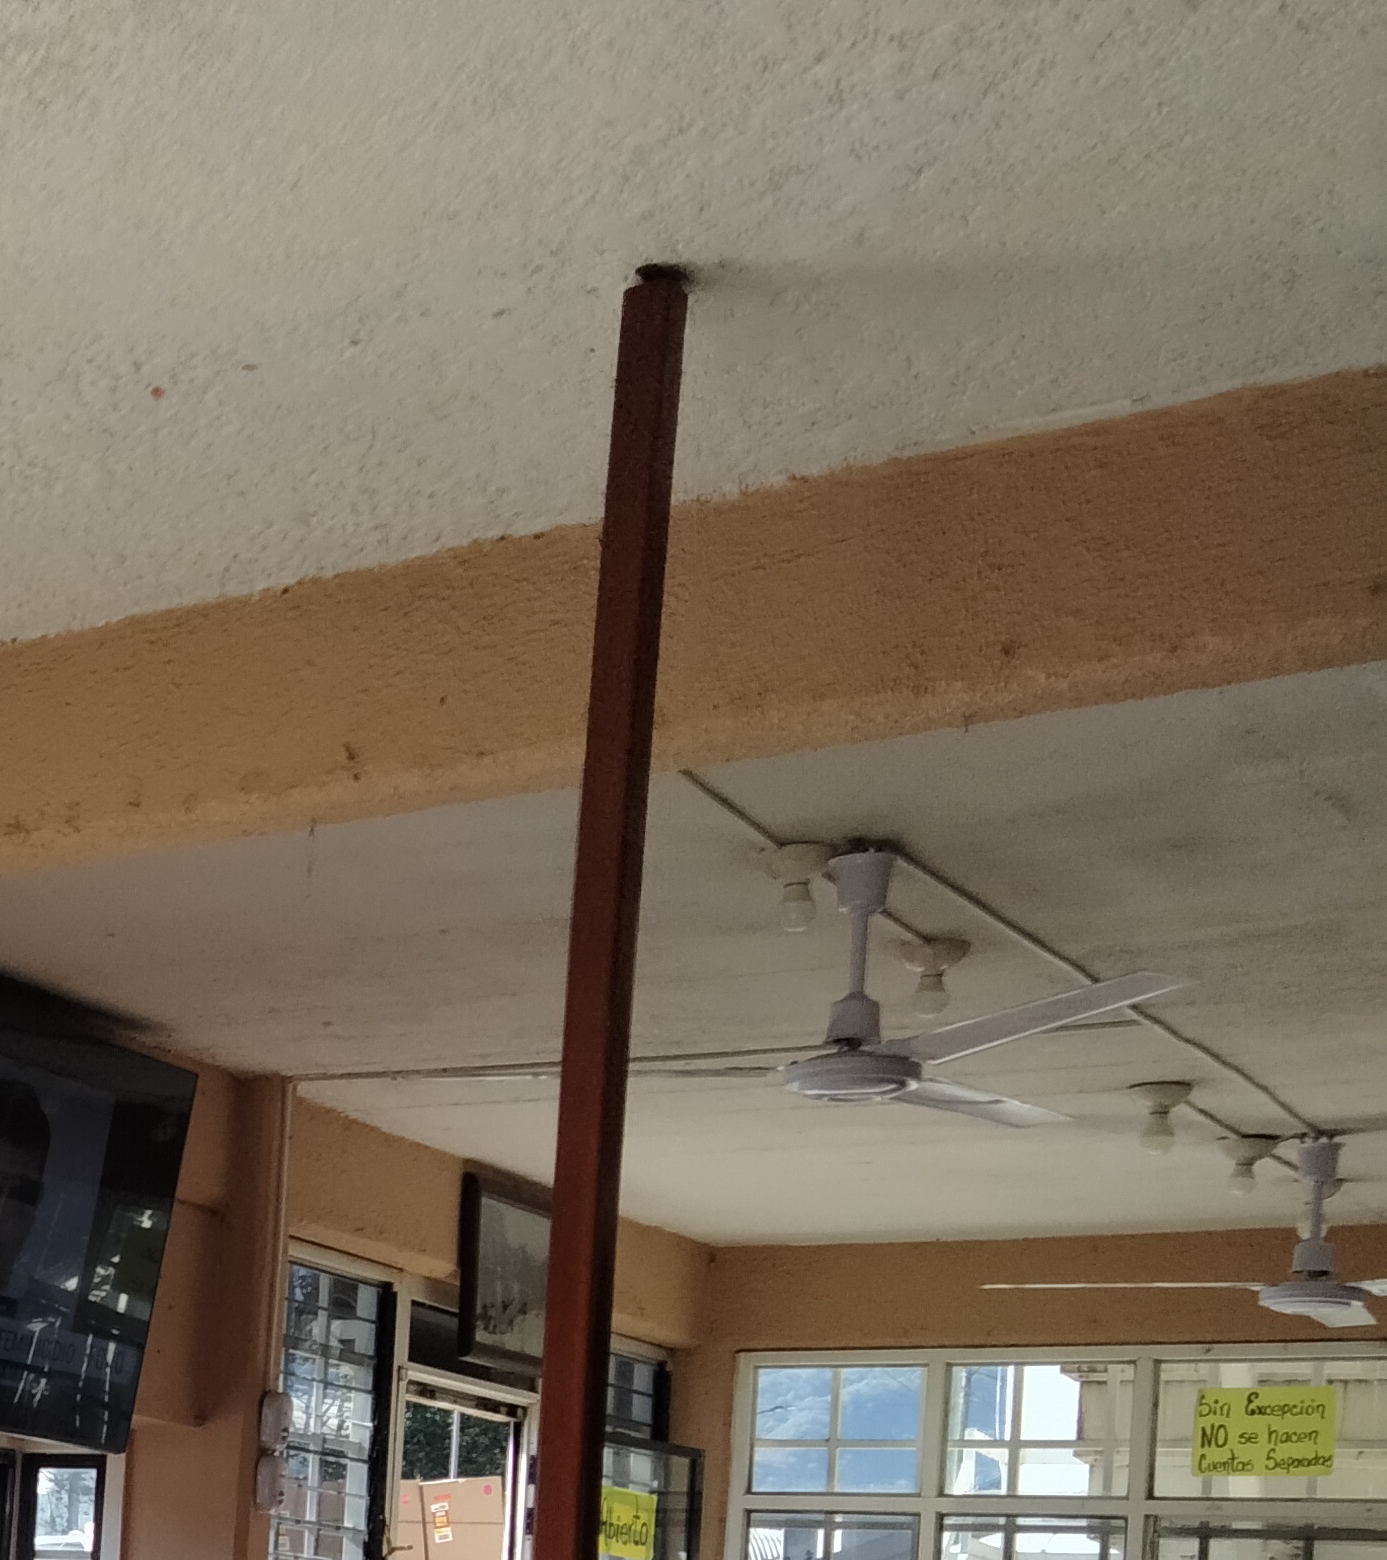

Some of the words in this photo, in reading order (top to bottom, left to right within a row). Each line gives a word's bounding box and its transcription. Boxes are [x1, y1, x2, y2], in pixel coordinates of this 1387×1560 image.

[1198, 1394, 1231, 1418] Sin
[1200, 1423, 1228, 1449] NO
[1237, 1431, 1260, 1445] se
[1267, 1424, 1319, 1447] hacen
[1198, 1448, 1255, 1474] Cuentas
